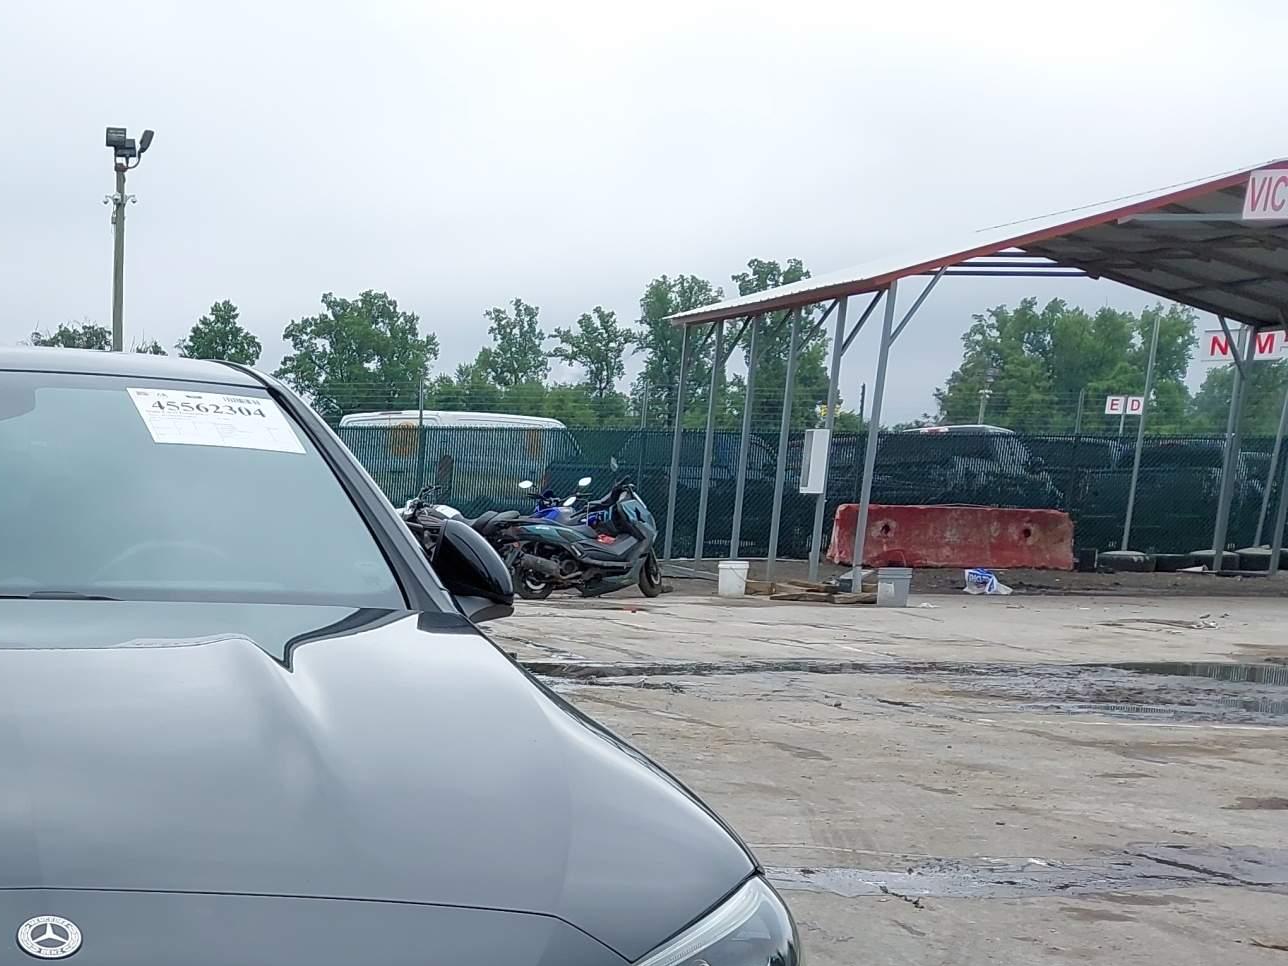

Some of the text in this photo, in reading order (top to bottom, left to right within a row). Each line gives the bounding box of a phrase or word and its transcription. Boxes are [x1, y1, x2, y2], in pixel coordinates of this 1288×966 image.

[152, 400, 266, 418] 45562304
[1110, 399, 1119, 410] E
[1131, 399, 1141, 411] D
